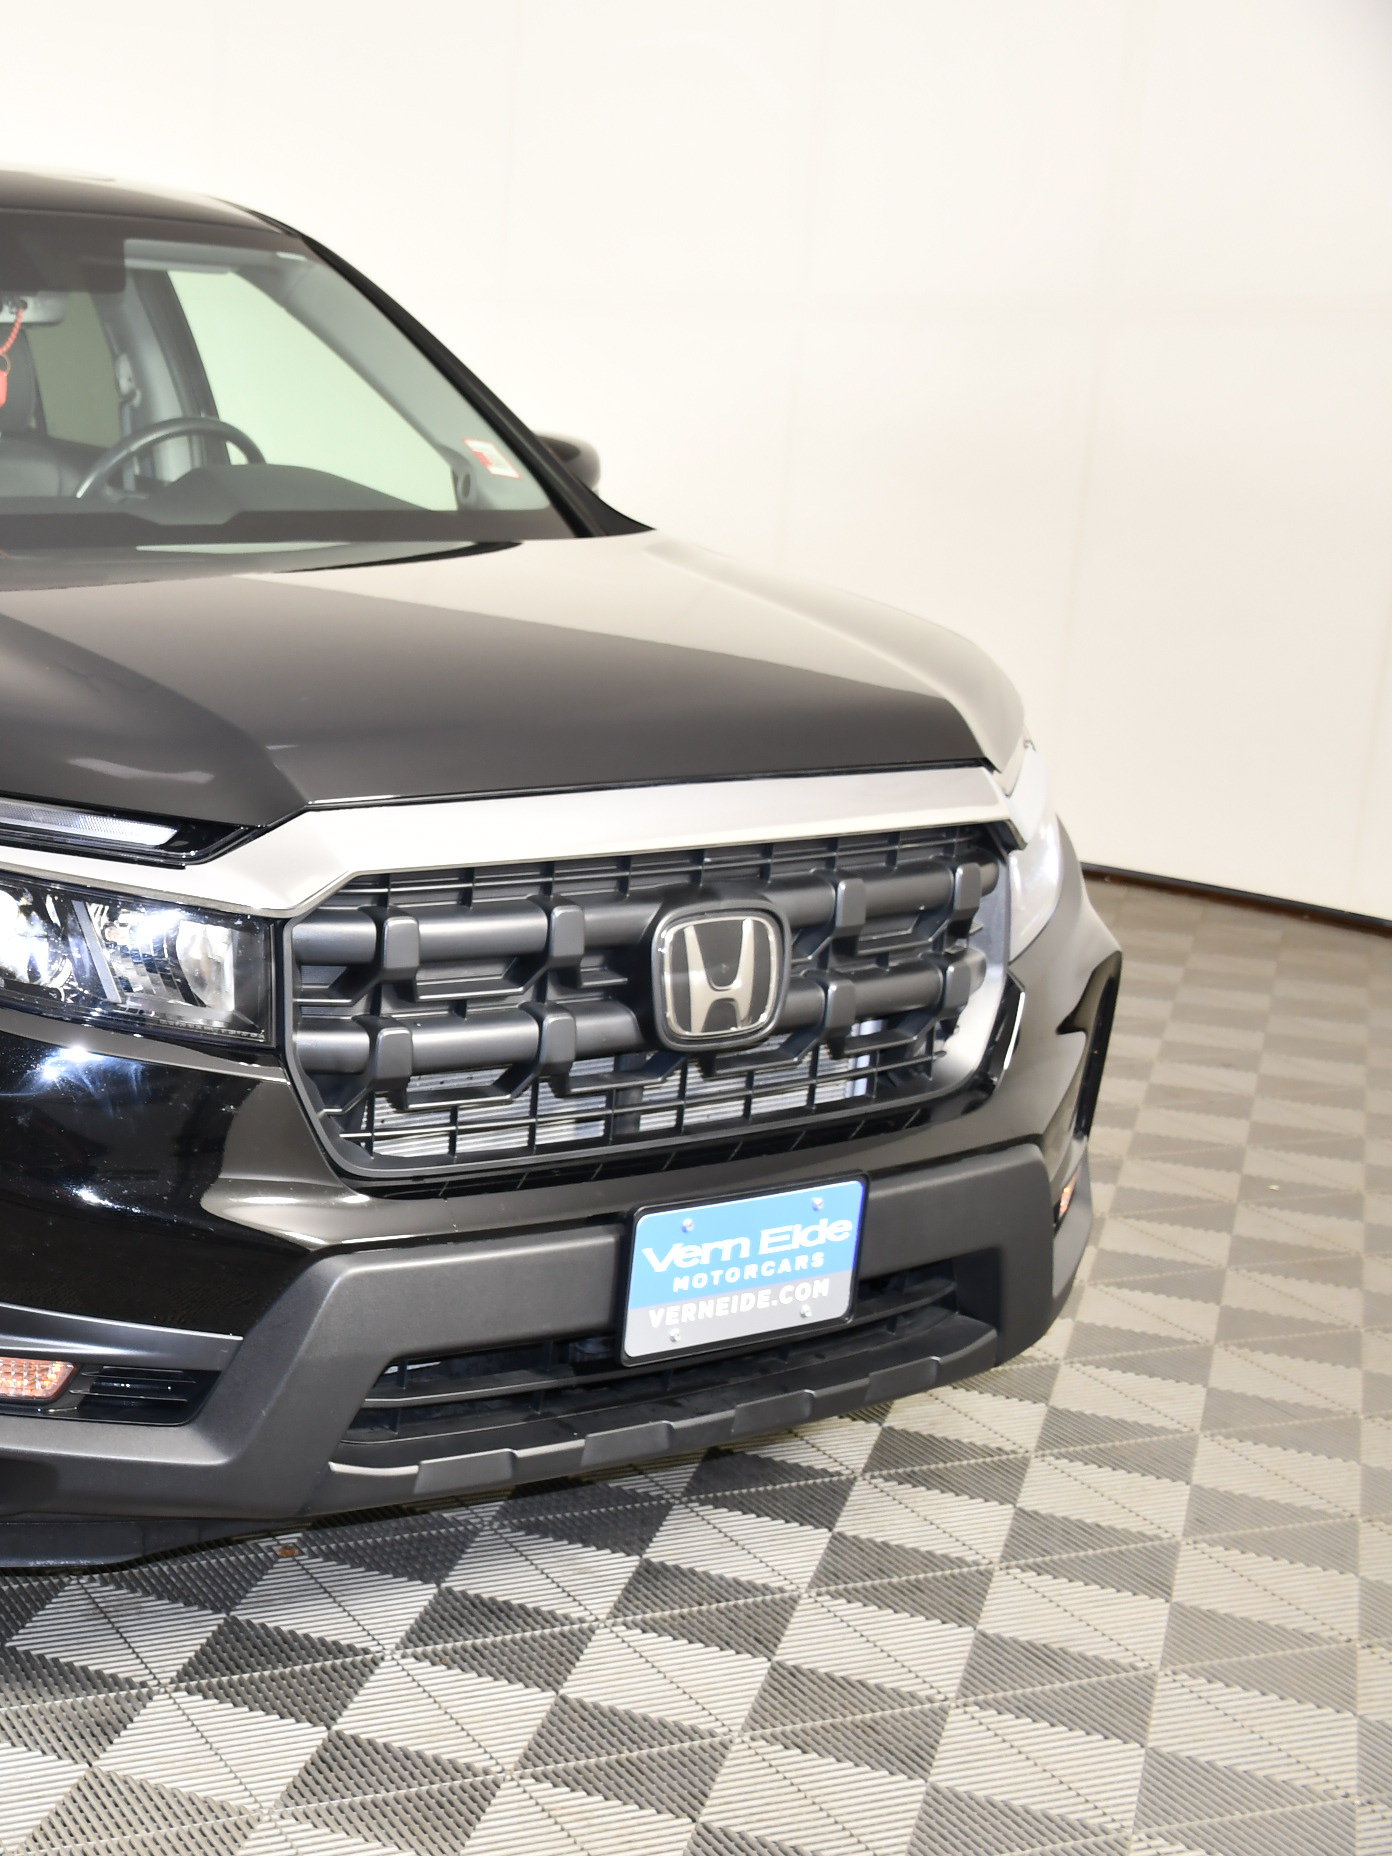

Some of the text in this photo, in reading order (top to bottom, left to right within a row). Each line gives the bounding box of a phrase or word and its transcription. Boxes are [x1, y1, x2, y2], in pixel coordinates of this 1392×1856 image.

[642, 1236, 750, 1273] Vern
[673, 1252, 825, 1292] MOTORCARS
[649, 1279, 829, 1328] VERNEIDE.COM
